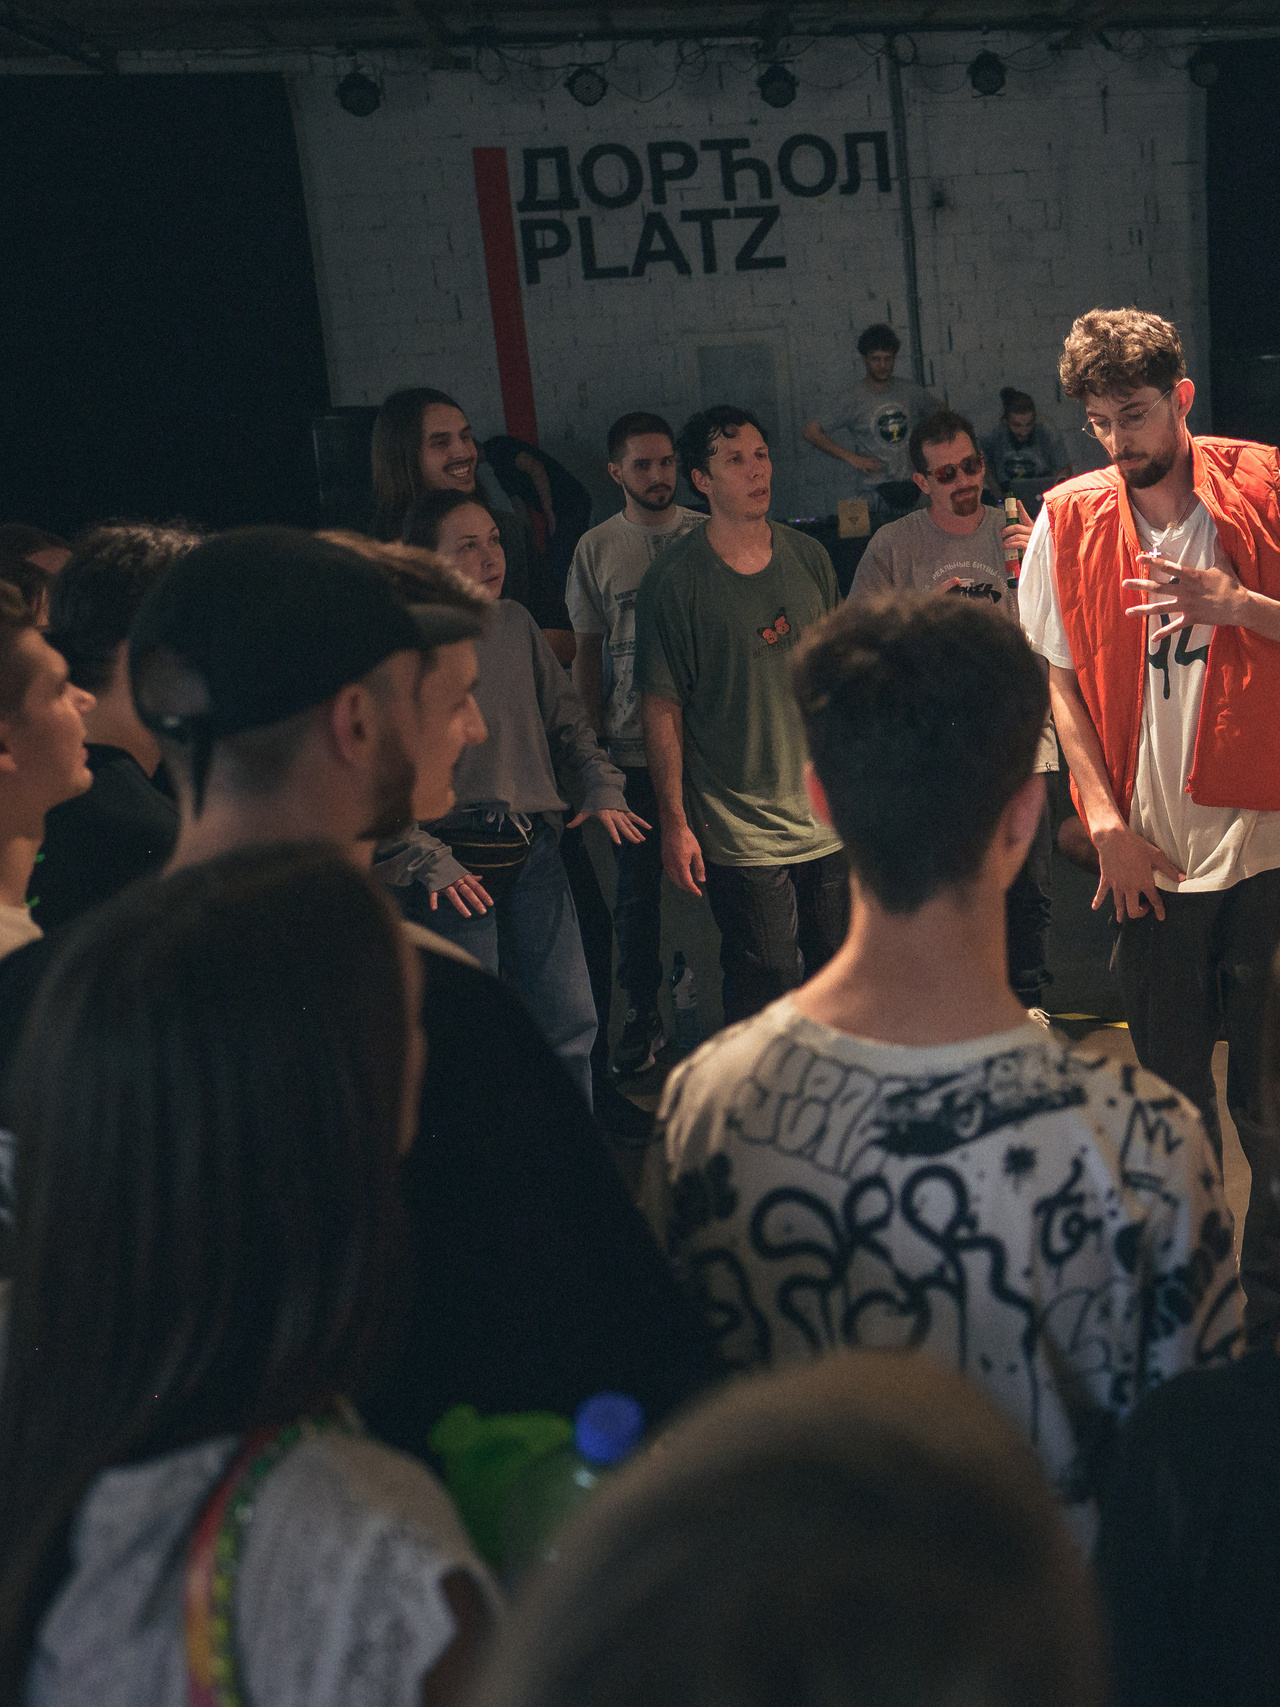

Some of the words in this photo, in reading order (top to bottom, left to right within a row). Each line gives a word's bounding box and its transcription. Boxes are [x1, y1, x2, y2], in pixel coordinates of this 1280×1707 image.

[516, 131, 892, 213] ДОРЋОЛ
[519, 205, 787, 285] PLATZ
[932, 560, 971, 581] РЕАЛЬНЫЕ
[972, 560, 998, 577] БИТВЫ
